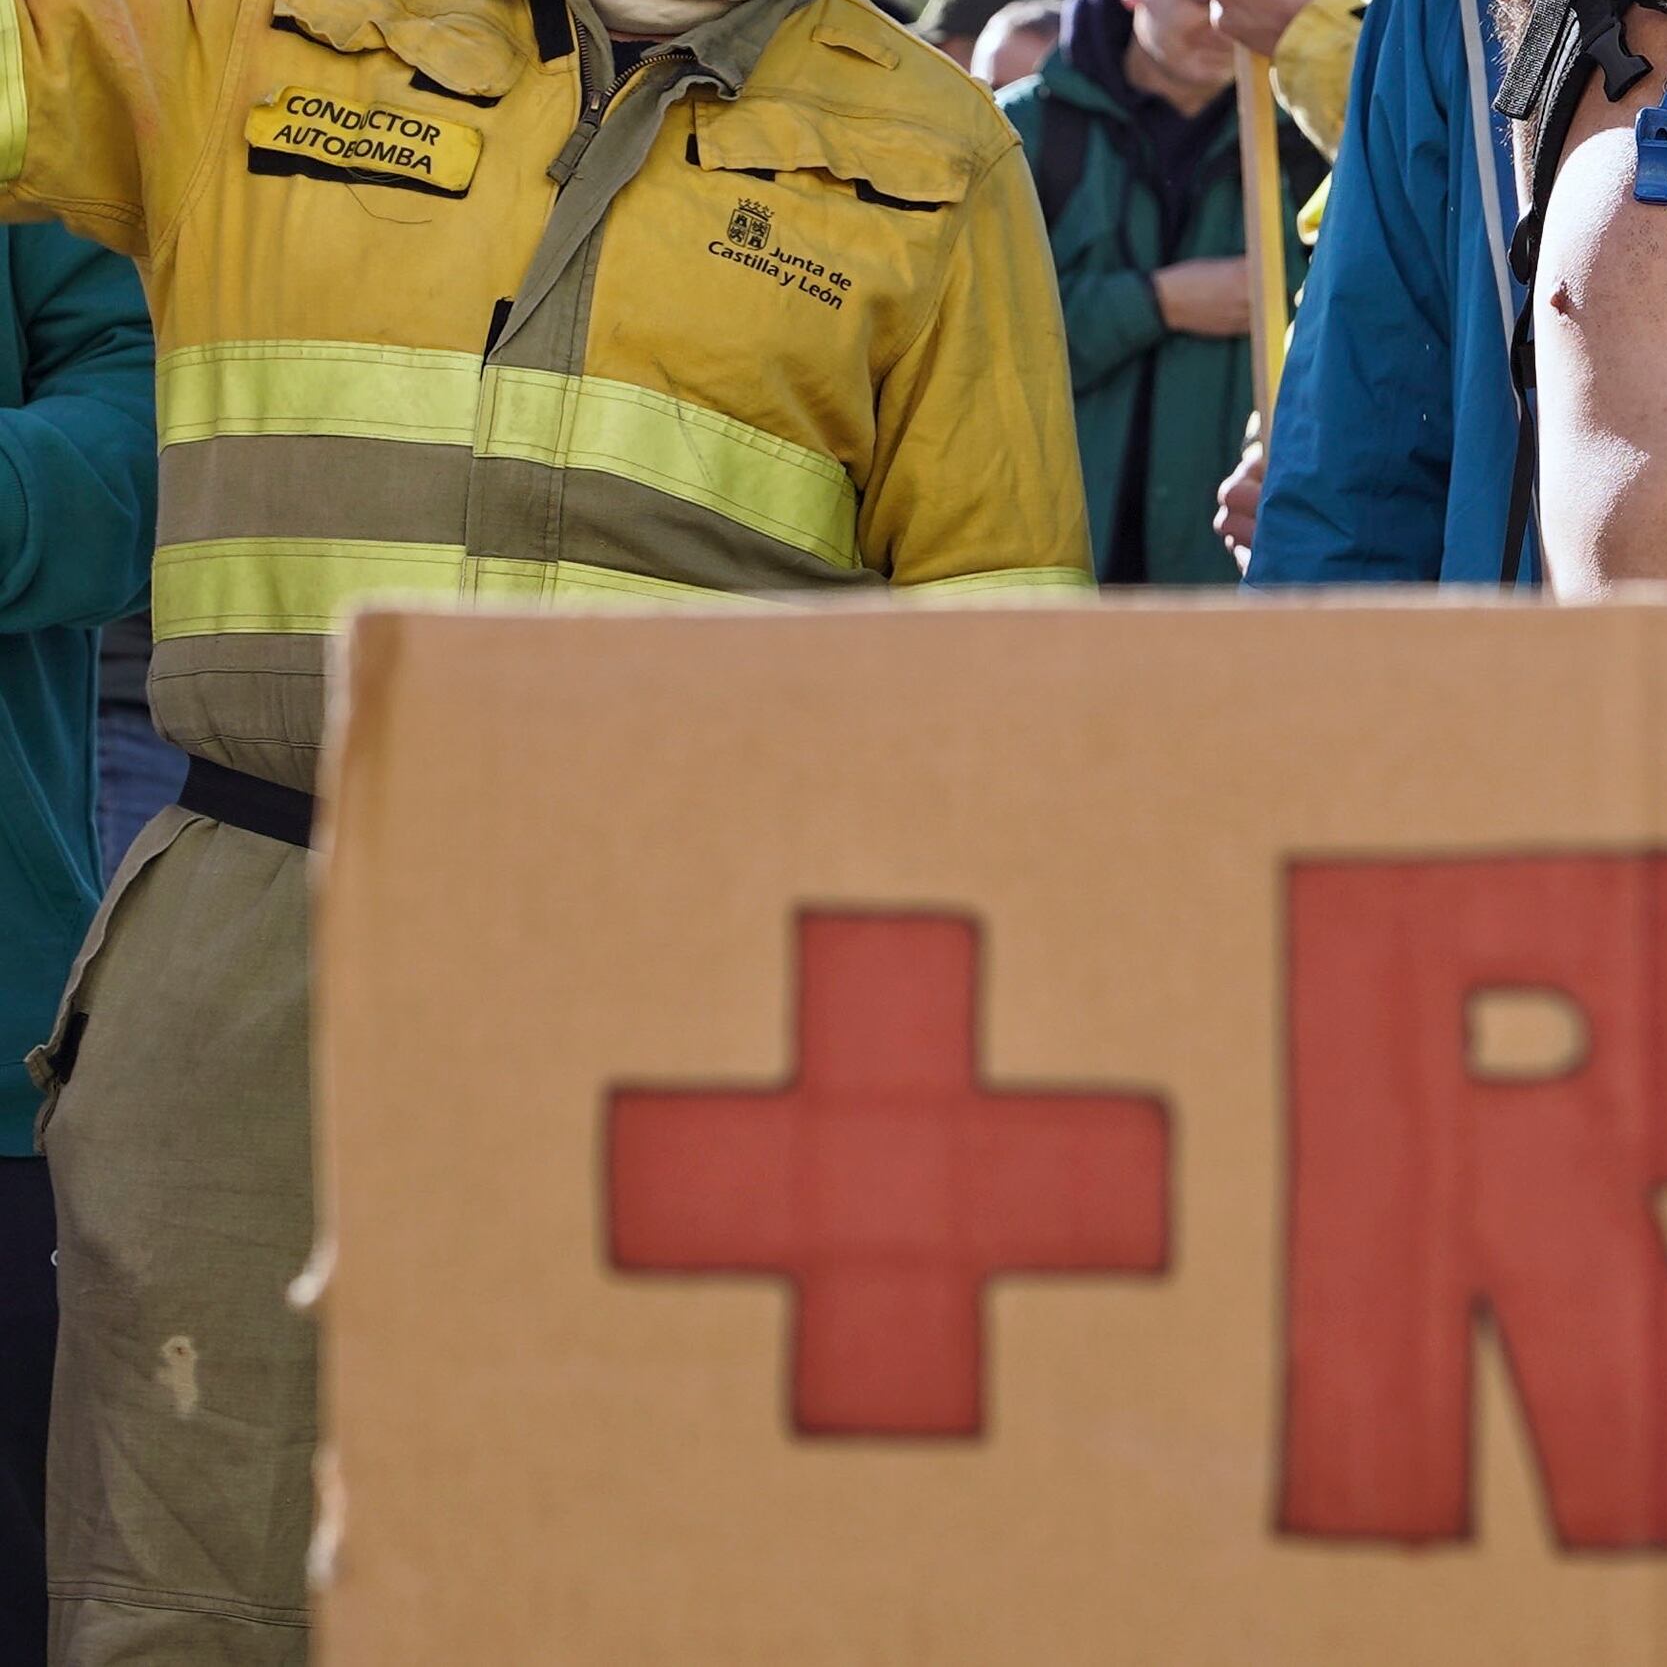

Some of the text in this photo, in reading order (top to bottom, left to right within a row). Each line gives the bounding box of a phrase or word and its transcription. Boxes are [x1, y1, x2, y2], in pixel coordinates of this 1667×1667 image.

[286, 95, 442, 147] CONDUCTOR
[708, 240, 843, 310] Castilla y León
[768, 247, 852, 291] Junta de
[603, 901, 1176, 1442] +
